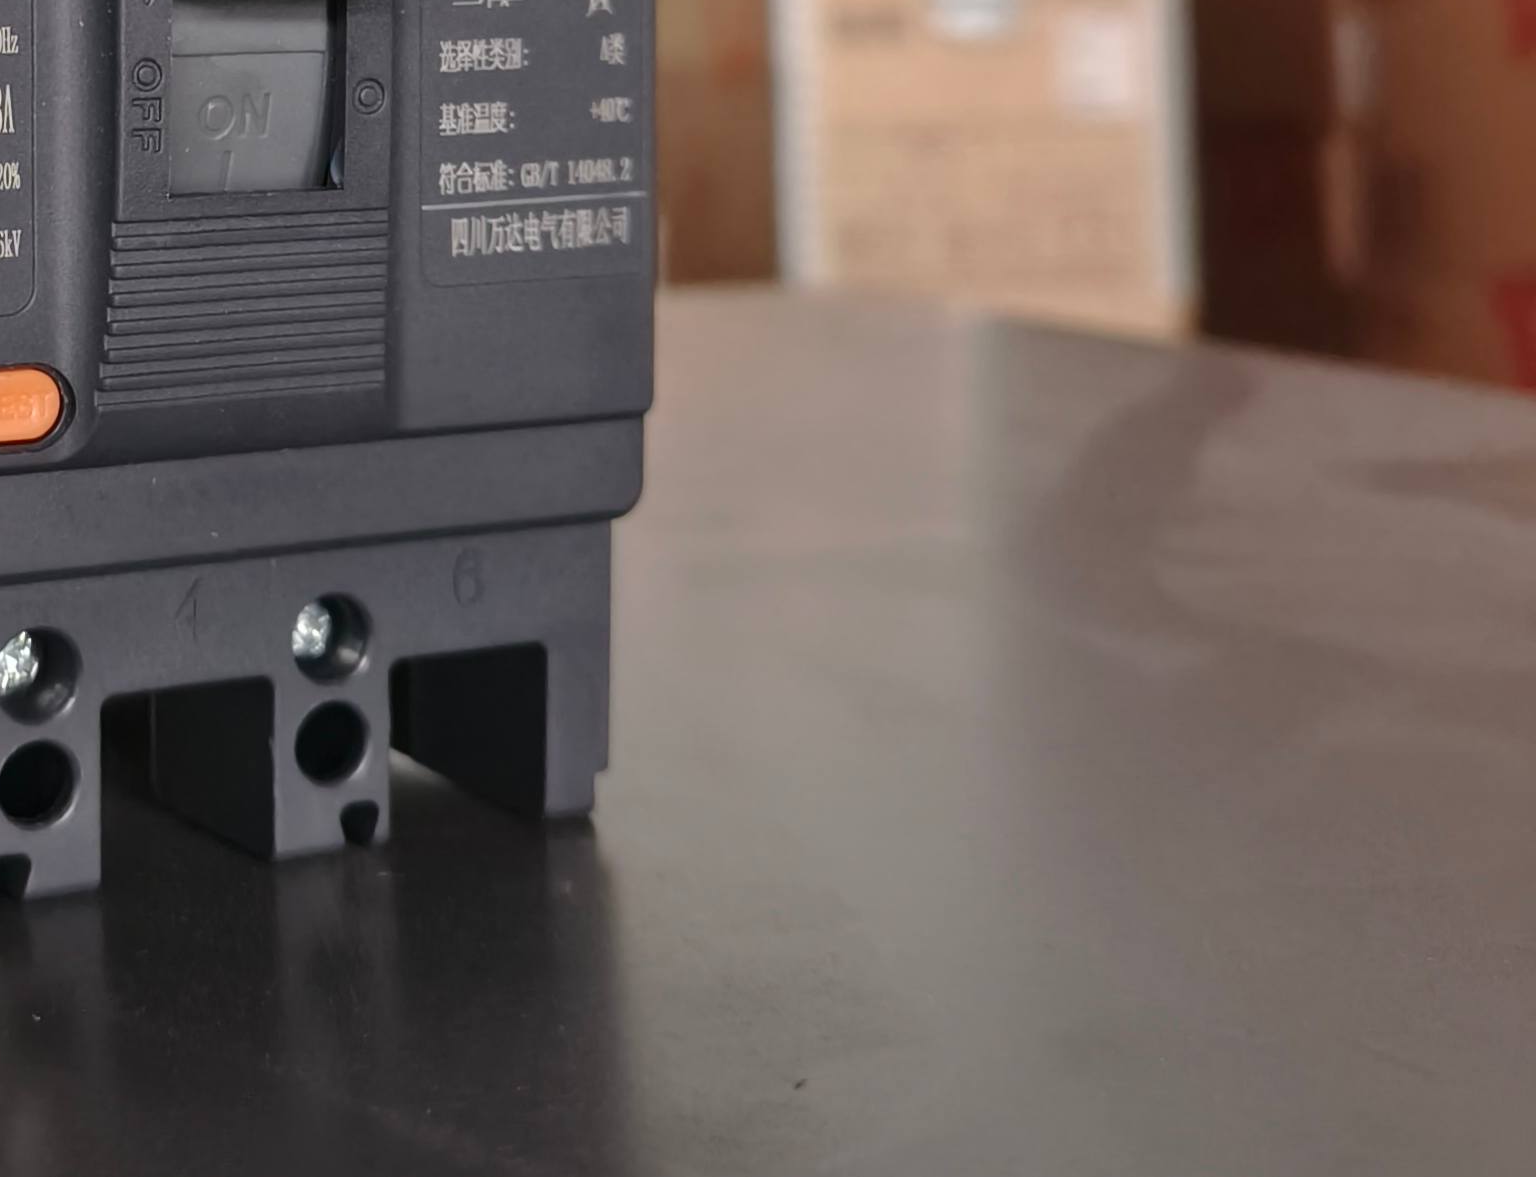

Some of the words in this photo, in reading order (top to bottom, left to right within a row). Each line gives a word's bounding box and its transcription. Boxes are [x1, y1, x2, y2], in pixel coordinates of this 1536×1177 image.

[130, 58, 162, 153] OFF
[199, 92, 272, 141] ON
[451, 206, 631, 257] 四川万达电气有限公司
[452, 547, 485, 607] 6
